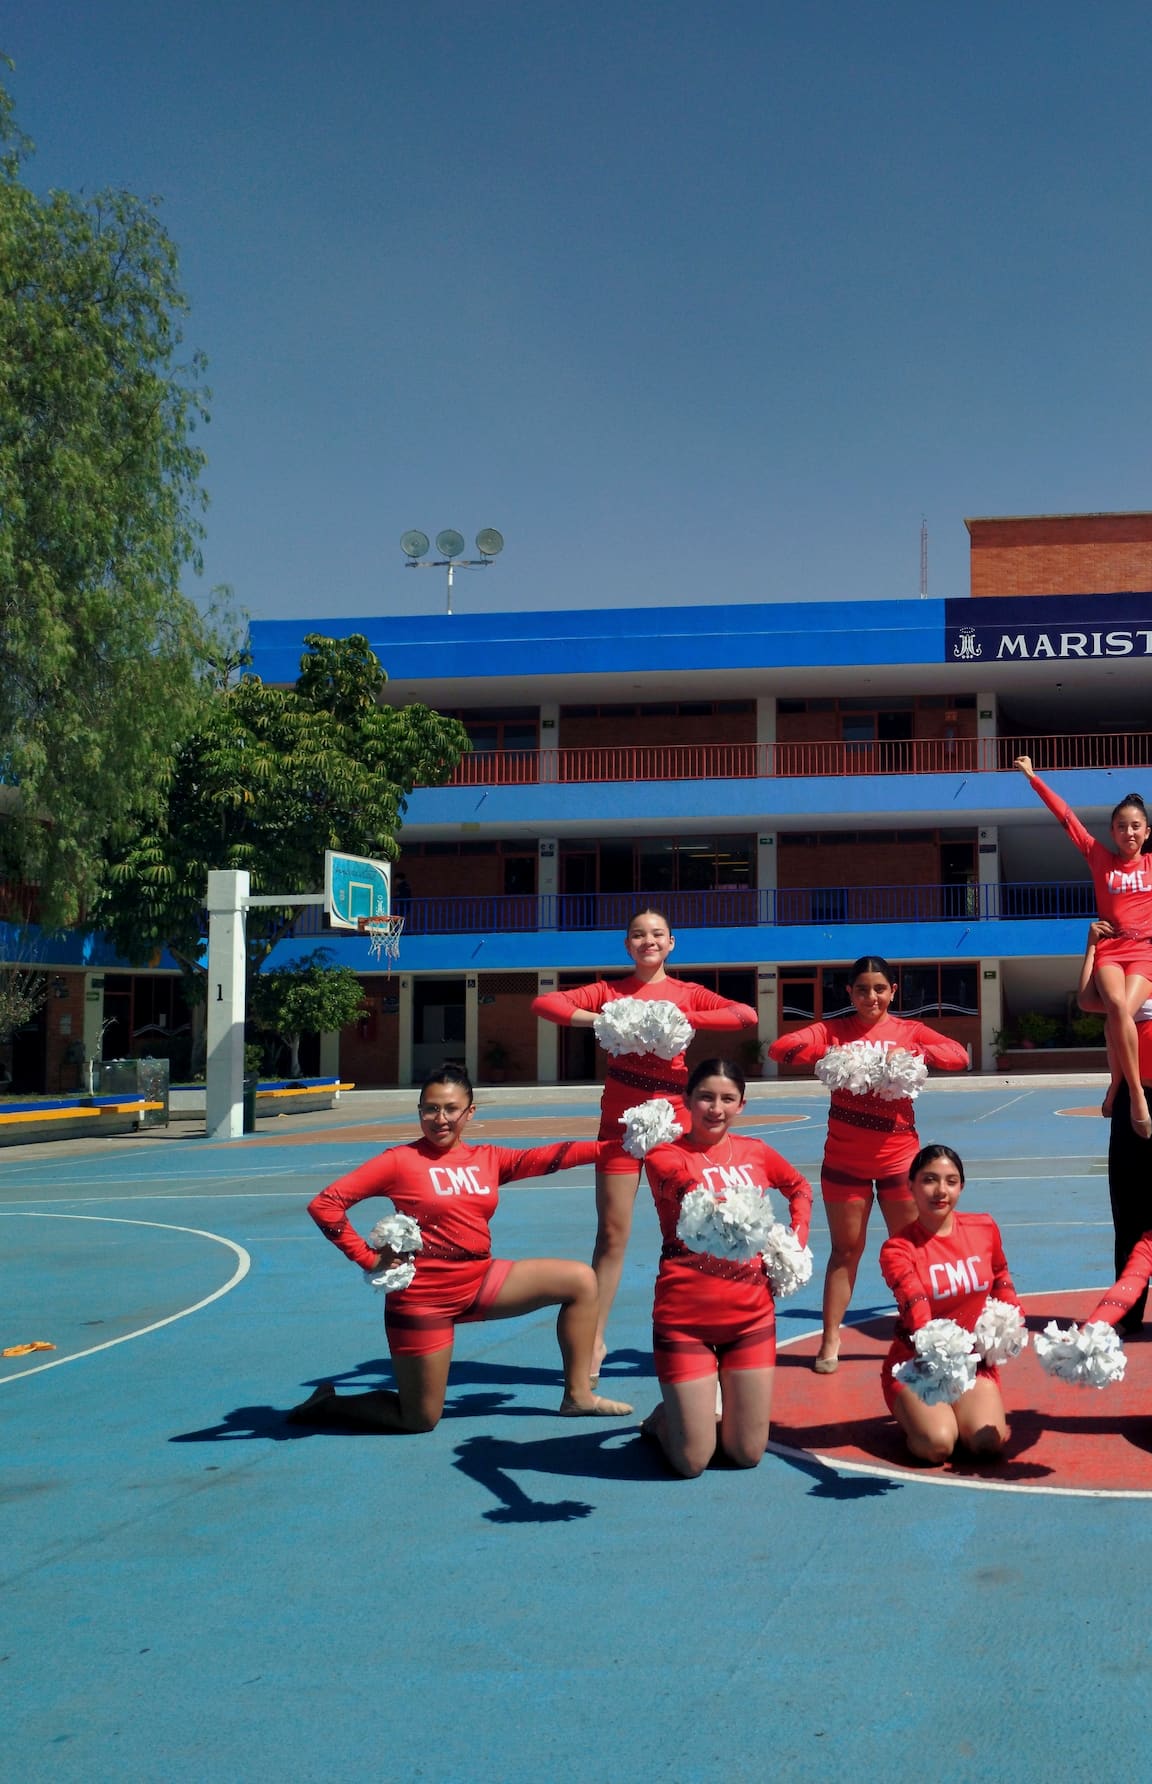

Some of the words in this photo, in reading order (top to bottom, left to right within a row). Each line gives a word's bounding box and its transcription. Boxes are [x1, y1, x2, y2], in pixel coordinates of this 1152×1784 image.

[1107, 870, 1152, 894] CMC
[216, 983, 224, 1001] 1
[429, 1165, 490, 1196] CMC
[929, 1255, 989, 1299] CMC
